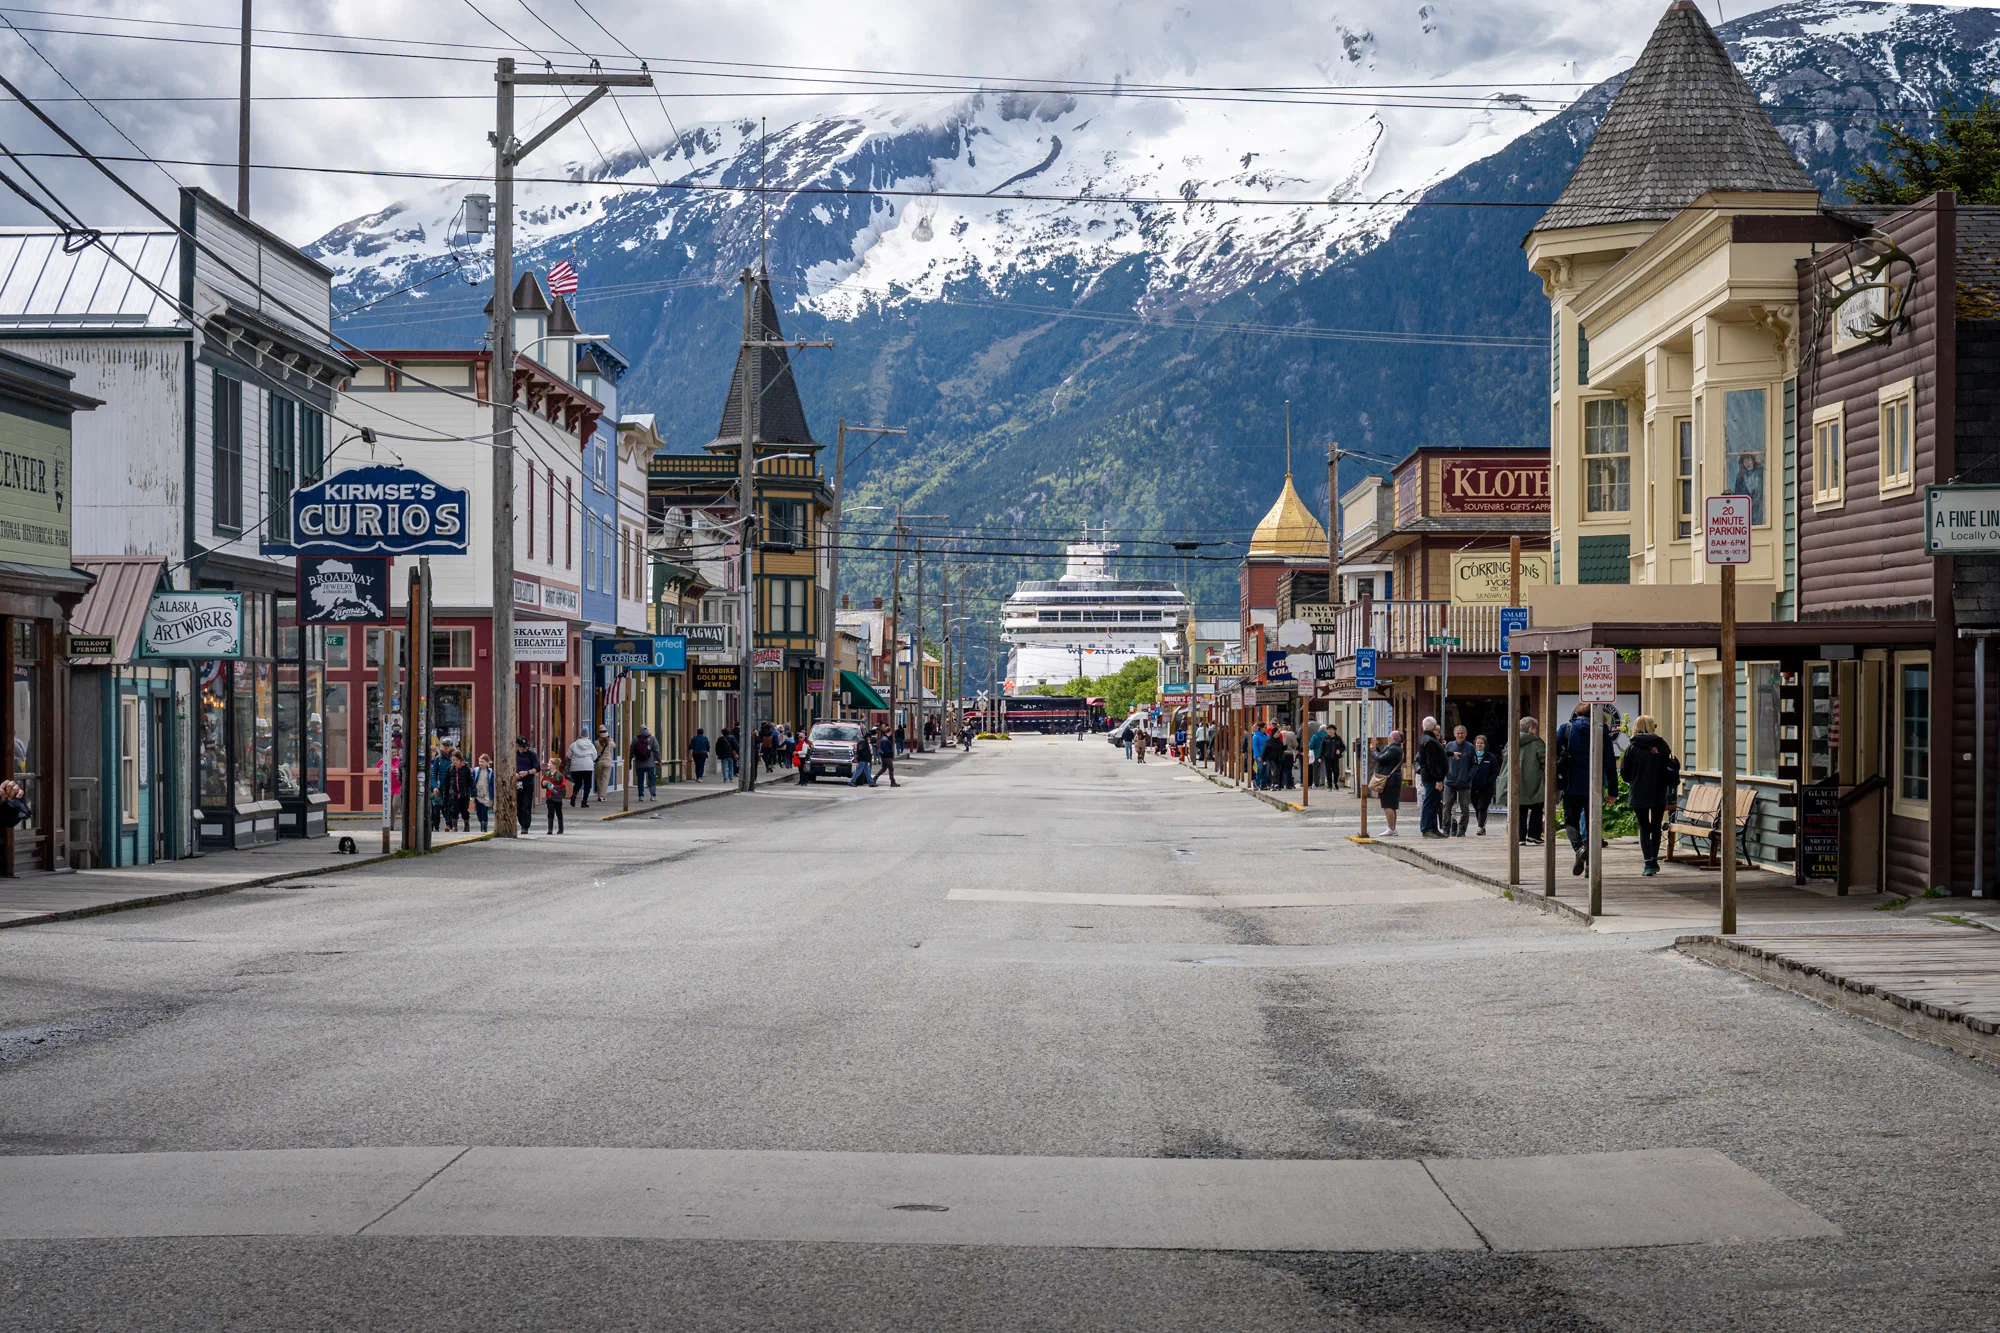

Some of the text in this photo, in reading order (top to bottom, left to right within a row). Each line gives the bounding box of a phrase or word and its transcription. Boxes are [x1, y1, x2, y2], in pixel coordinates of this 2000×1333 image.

[325, 483, 436, 500] KIRMSE'S
[1464, 503, 1505, 511] SOUVENIRS
[1510, 503, 1530, 511] GIFTS
[1722, 506, 1734, 515] 20
[299, 503, 461, 536] CURIOS
[1712, 517, 1744, 525] MINUTE
[1936, 511, 1945, 528] A
[1949, 510, 1976, 528] FINE
[22, 524, 54, 545] HISTORICAL
[55, 529, 68, 546] PARK
[1709, 527, 1747, 535] PARKING
[1951, 531, 1986, 542] Locally
[1460, 561, 1540, 581] CORRINGON'S
[308, 572, 374, 586] BROADWAY
[158, 601, 198, 613] ALASKA
[154, 610, 233, 640] ARTWORKS
[655, 640, 682, 648] erfect
[1208, 666, 1257, 675] PANTHEON
